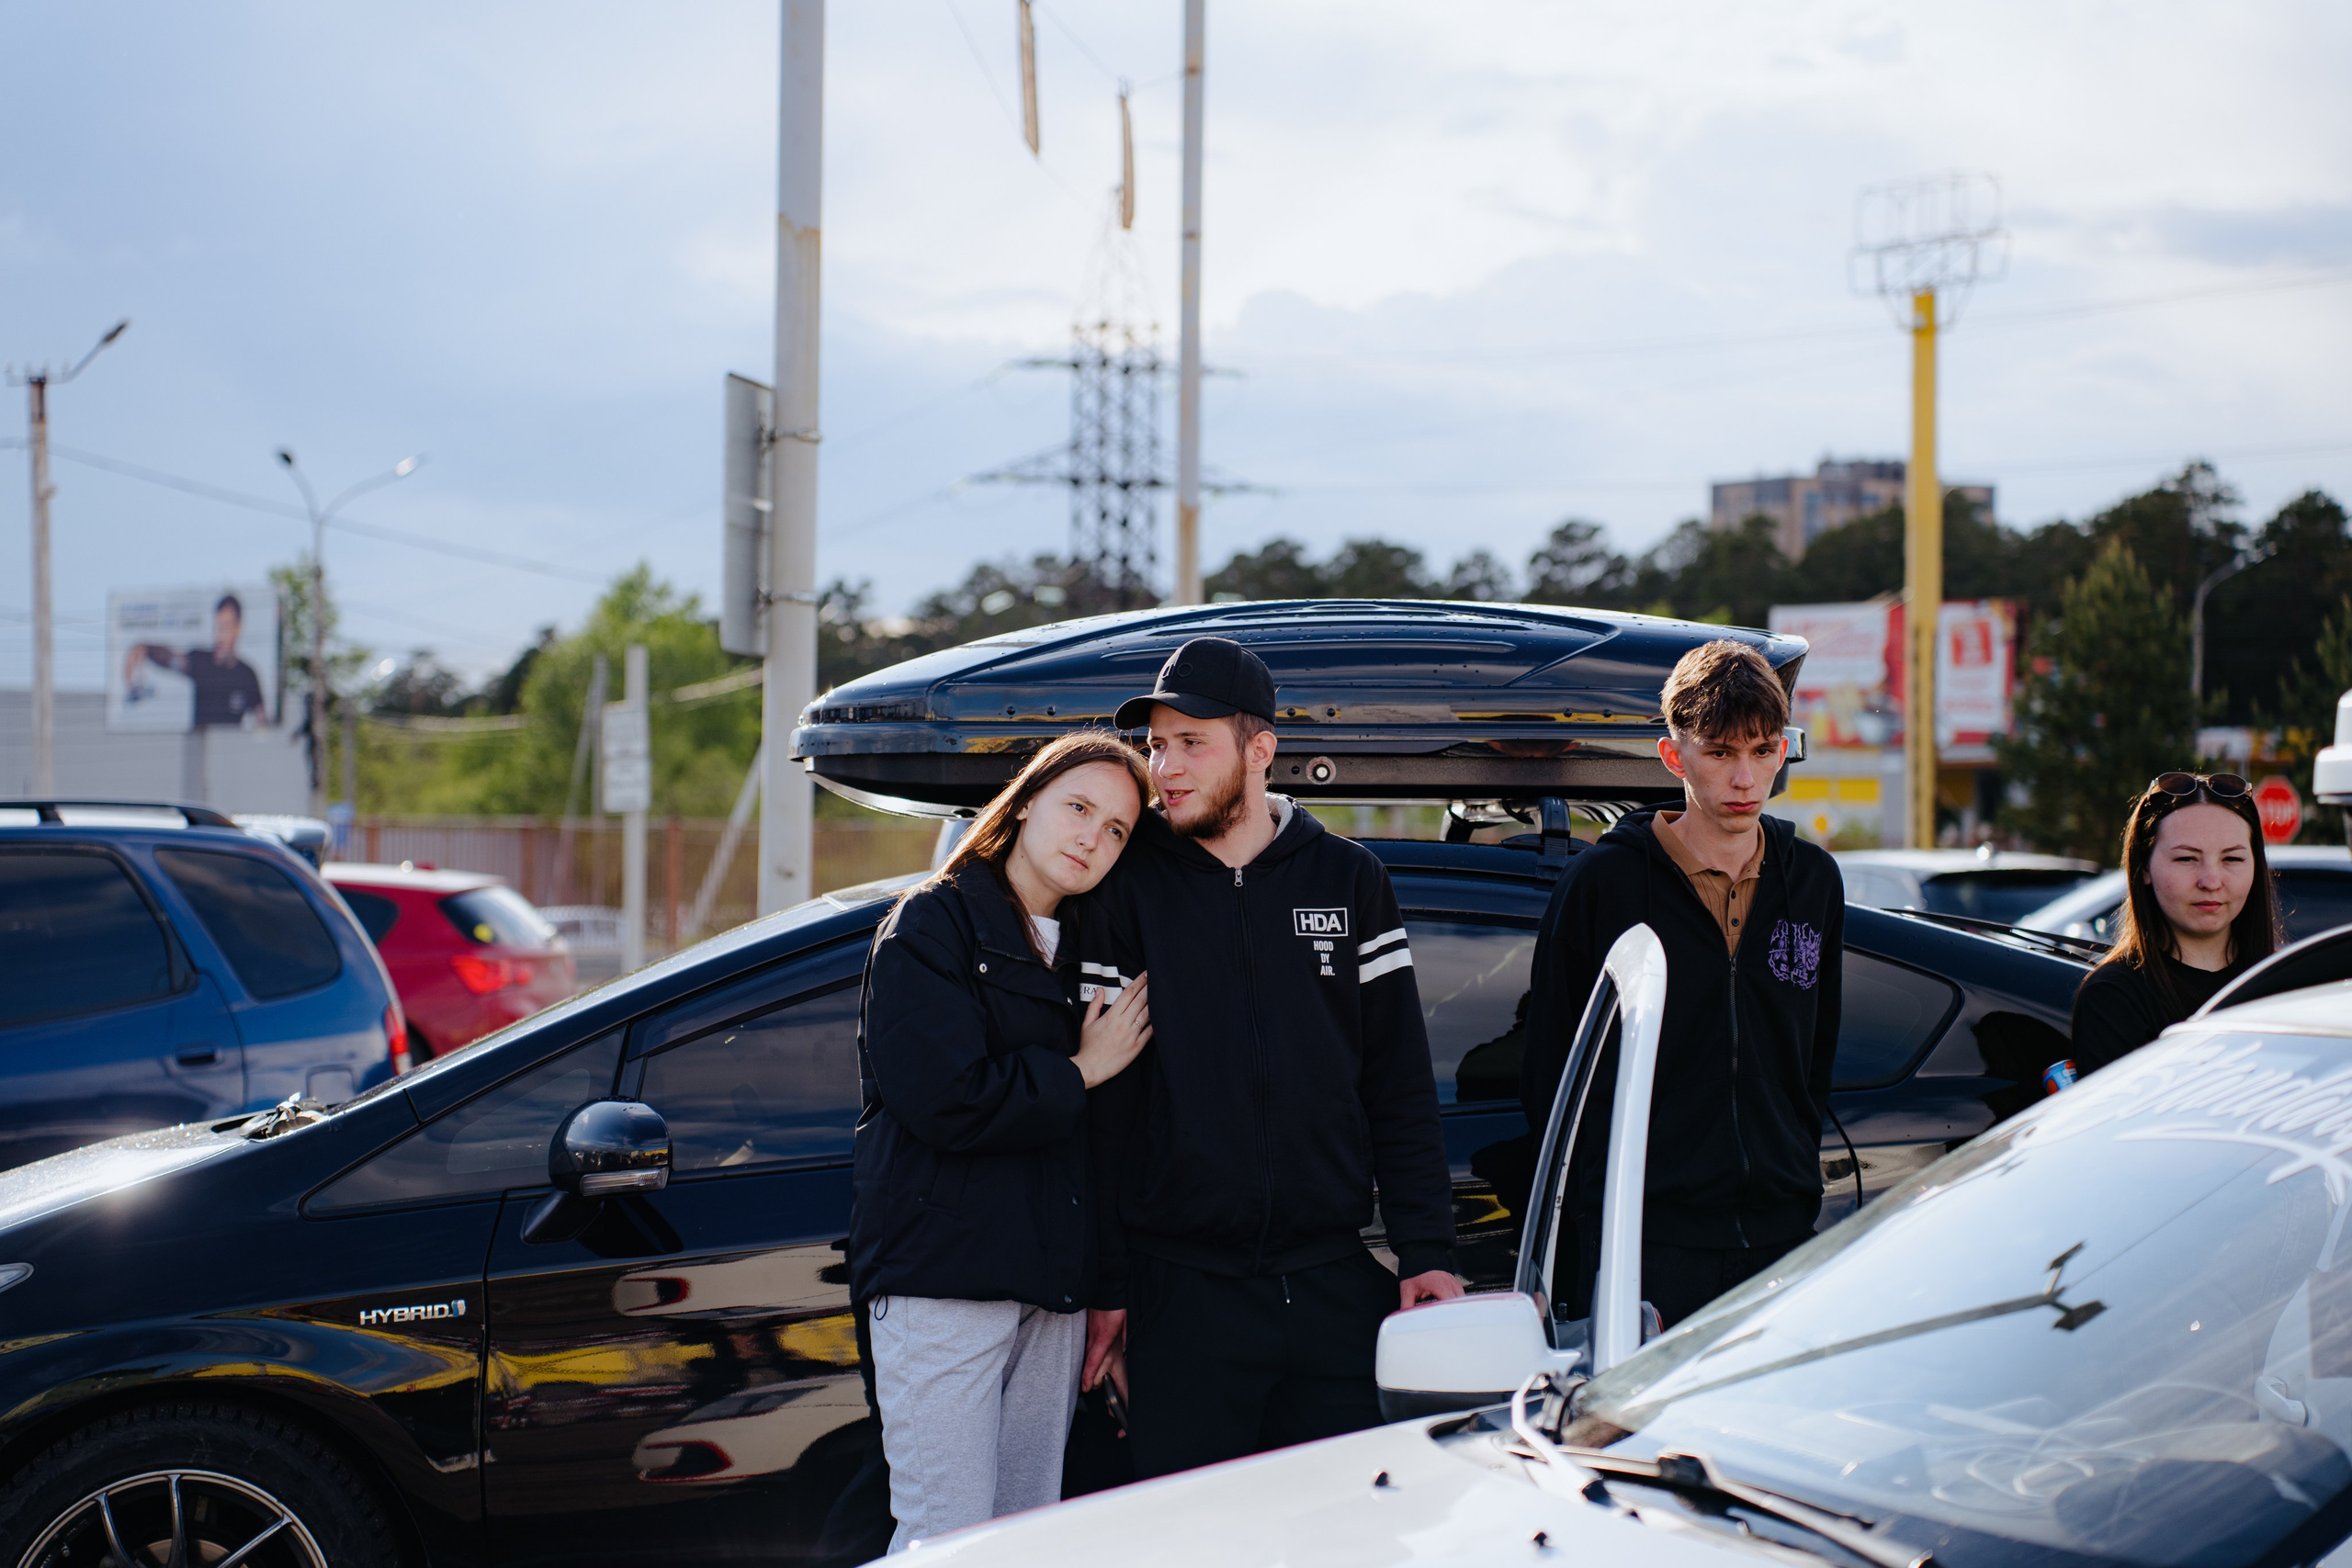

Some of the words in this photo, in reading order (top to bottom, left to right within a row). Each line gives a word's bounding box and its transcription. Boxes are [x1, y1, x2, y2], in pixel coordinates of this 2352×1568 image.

[1300, 913, 1342, 932] HDA
[1313, 940, 1334, 952] HOOD
[1320, 964, 1336, 976] AIR.
[359, 1303, 450, 1325] HYBRID
